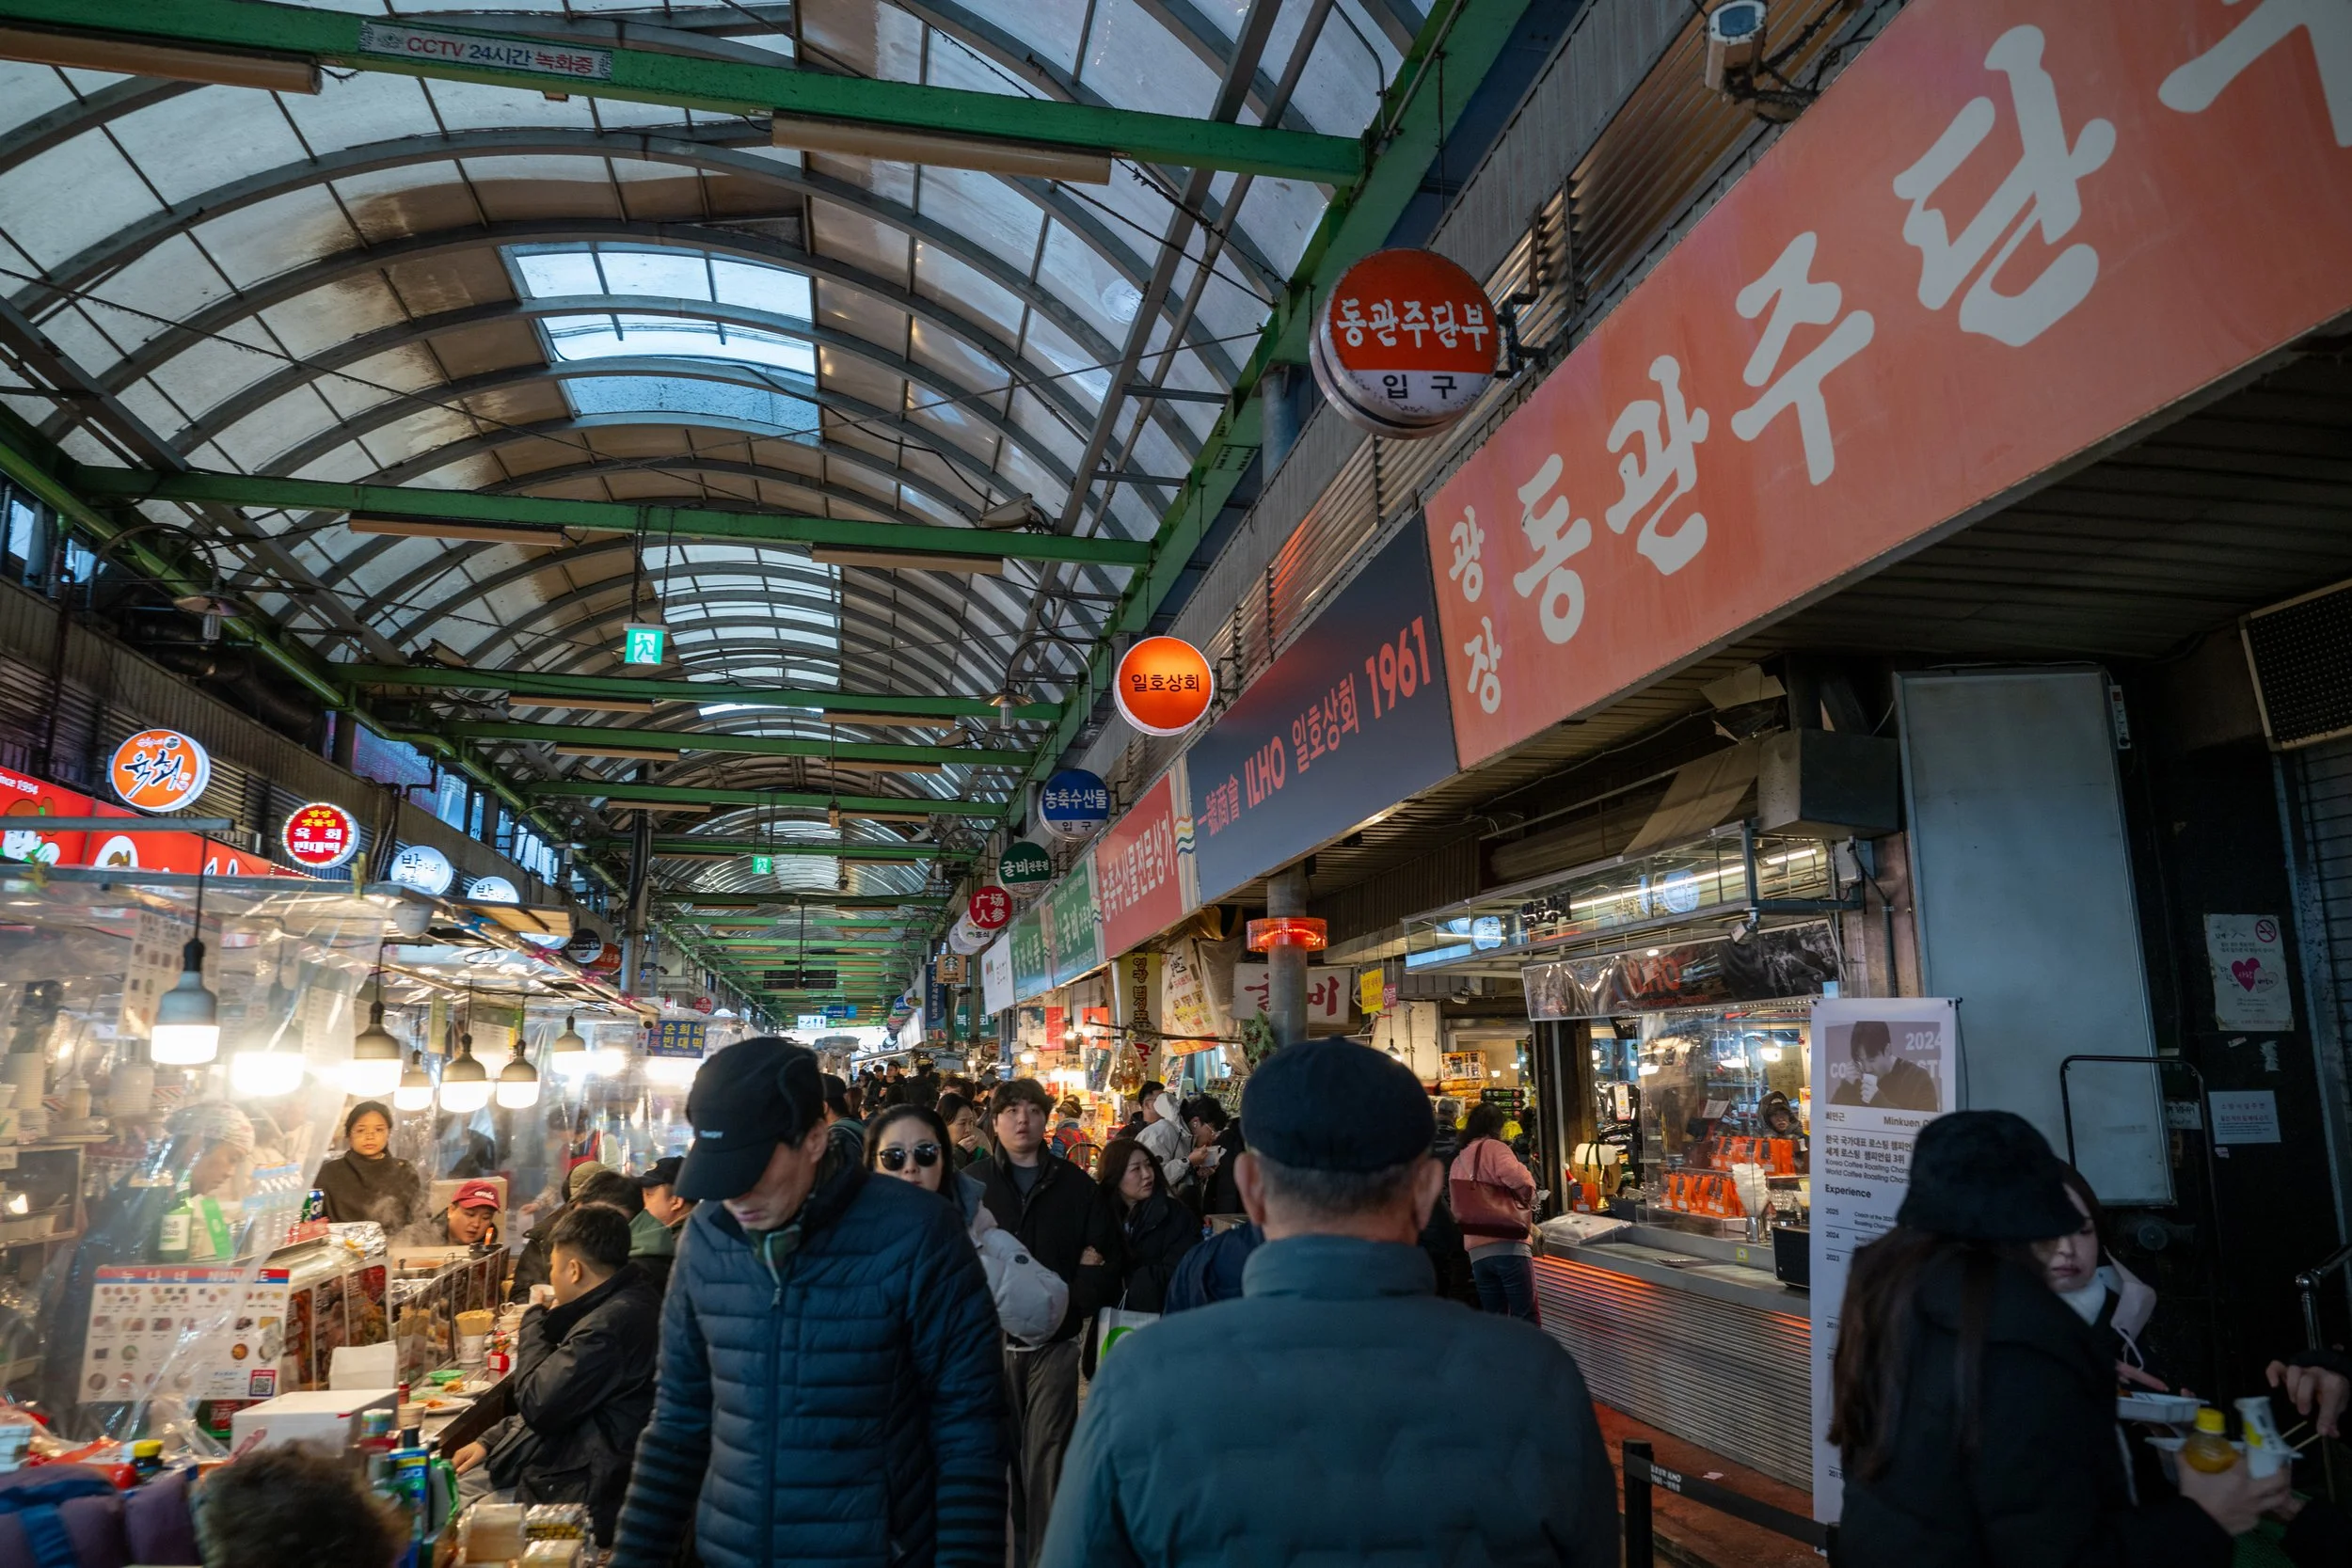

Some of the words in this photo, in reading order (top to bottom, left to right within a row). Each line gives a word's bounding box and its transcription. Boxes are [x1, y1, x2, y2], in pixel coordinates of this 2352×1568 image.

[406, 37, 465, 56] CCTV
[469, 44, 532, 67] 24시간
[534, 52, 594, 73] 녹화중
[1336, 297, 1489, 352] 동관주단부
[1131, 673, 1200, 692] 일호상회
[1245, 736, 1285, 809] ILHO
[1291, 672, 1359, 775] 일호상회
[1365, 615, 1431, 719] 1961
[16, 780, 39, 796] 1994
[1045, 788, 1107, 809] 농축수산물
[294, 841, 341, 854] 빈대떡
[1101, 810, 1175, 923] 농축수산물전문상가
[976, 893, 1005, 909] 广场
[977, 909, 1006, 923] 人参
[663, 1022, 705, 1037] 순희네
[662, 1036, 704, 1050] 빈대떡
[1905, 1031, 1942, 1051] 2024
[1883, 1117, 1919, 1128] Minkuen
[1825, 1134, 1839, 1145] 한국
[1840, 1136, 1867, 1148] 국가대표
[1868, 1138, 1888, 1150] 로스팅
[1825, 1147, 1839, 1157] 세계
[1840, 1148, 1860, 1159] 로스팅
[1893, 1154, 1905, 1164] 3위
[1825, 1158, 1842, 1166] Korea
[1844, 1160, 1863, 1169] Coffee
[1865, 1163, 1889, 1174] Roasting
[1825, 1167, 1842, 1176] World
[1843, 1169, 1863, 1179] Coffee
[1864, 1172, 1889, 1183] Roasting
[1825, 1183, 1872, 1199] Experience
